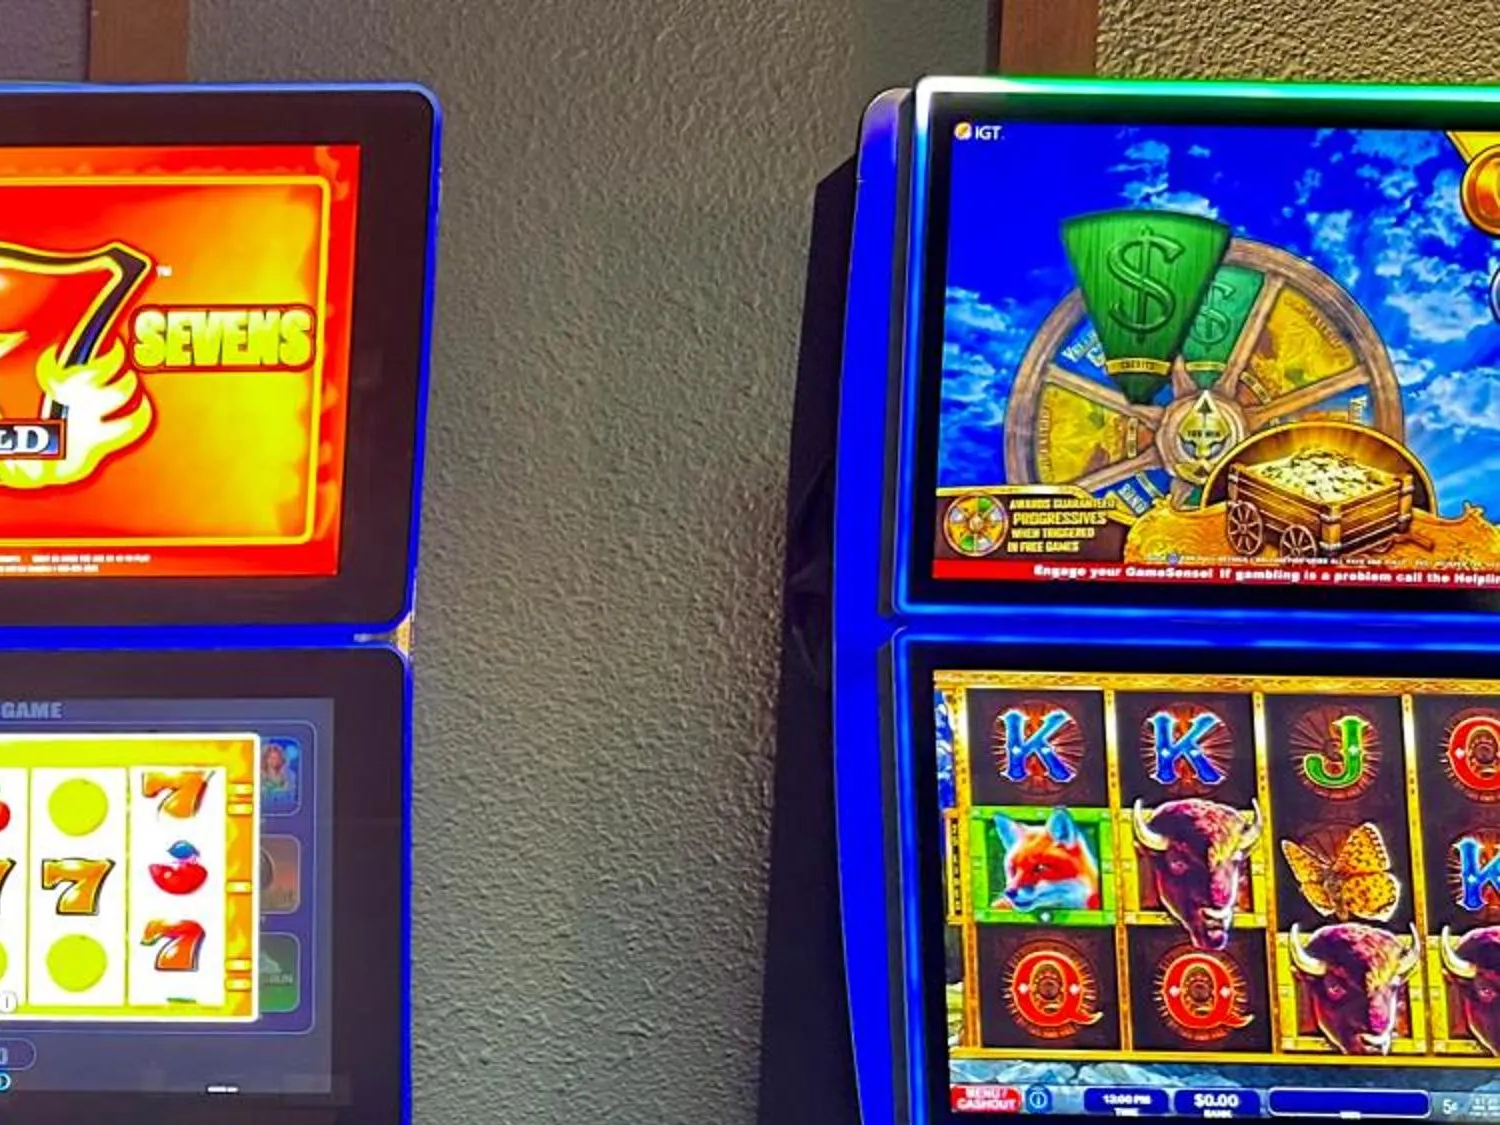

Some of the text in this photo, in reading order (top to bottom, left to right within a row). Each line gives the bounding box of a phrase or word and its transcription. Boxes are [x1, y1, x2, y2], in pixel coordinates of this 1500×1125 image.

[975, 125, 1002, 140] IGT
[133, 309, 312, 368] SEVENS
[1013, 511, 1107, 526] PROGRESSIVES
[1033, 564, 1087, 579] Engage
[1090, 567, 1122, 579] your
[1219, 567, 1232, 579] If
[1235, 568, 1300, 583] gambling
[1304, 569, 1317, 581] is
[1321, 572, 1331, 581] a
[1334, 570, 1392, 584] problem
[1396, 571, 1423, 582] call
[1427, 571, 1450, 583] the
[0, 701, 62, 719] GAME
[1000, 710, 1073, 783] K
[1147, 711, 1225, 783] K
[1303, 714, 1369, 789] J
[41, 857, 116, 917] 7
[1011, 949, 1255, 1029] Q Q
[1134, 1094, 1152, 1105] PM
[1194, 1094, 1239, 1108] $0.00
